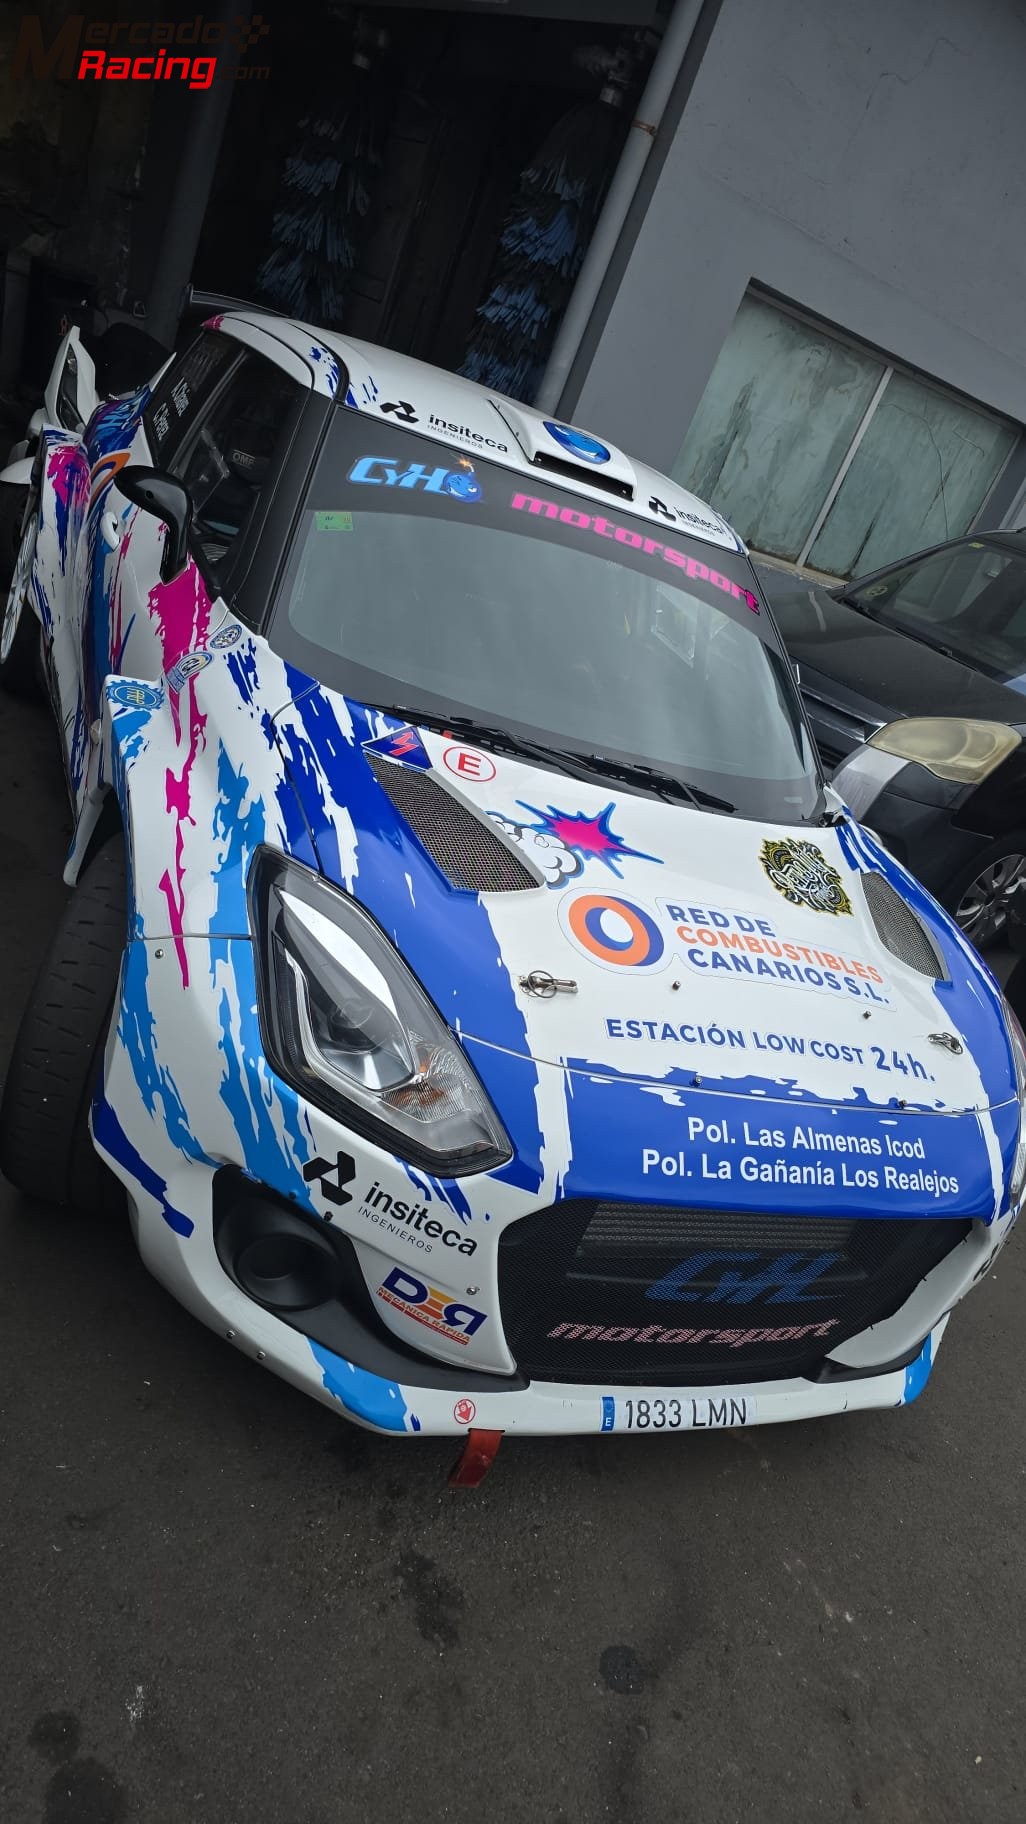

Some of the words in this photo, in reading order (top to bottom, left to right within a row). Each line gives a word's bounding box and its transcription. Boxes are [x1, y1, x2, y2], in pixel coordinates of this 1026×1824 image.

[429, 414, 508, 453] insiteca
[511, 492, 761, 616] motorsport
[458, 752, 481, 776] E
[666, 904, 730, 929] RED
[738, 914, 776, 938] DE
[676, 925, 884, 985] COMBUSTIBLES
[687, 948, 842, 991] CANARIOS
[847, 976, 890, 1004] S.L.
[606, 1018, 746, 1049] ESTACIÓN
[752, 1031, 805, 1055] LOW
[809, 1040, 864, 1065] COST
[870, 1046, 936, 1082] 24h.
[687, 1116, 736, 1145] Pol.
[744, 1121, 786, 1148] Las
[792, 1127, 882, 1157] Almenas
[886, 1134, 926, 1160] Icod
[642, 1148, 693, 1177] Pol.
[702, 1153, 732, 1181] La
[740, 1156, 836, 1187] Gañanía
[841, 1162, 879, 1189] Los
[885, 1166, 960, 1199] Realejos
[358, 1205, 433, 1253] INGENIEROS
[364, 1181, 478, 1257] insiteca
[432, 1319, 471, 1342] RAPIDA
[547, 1318, 840, 1349] motorsport
[605, 1416, 612, 1427] E
[625, 1398, 682, 1429] 1833
[691, 1397, 747, 1428] LMN
